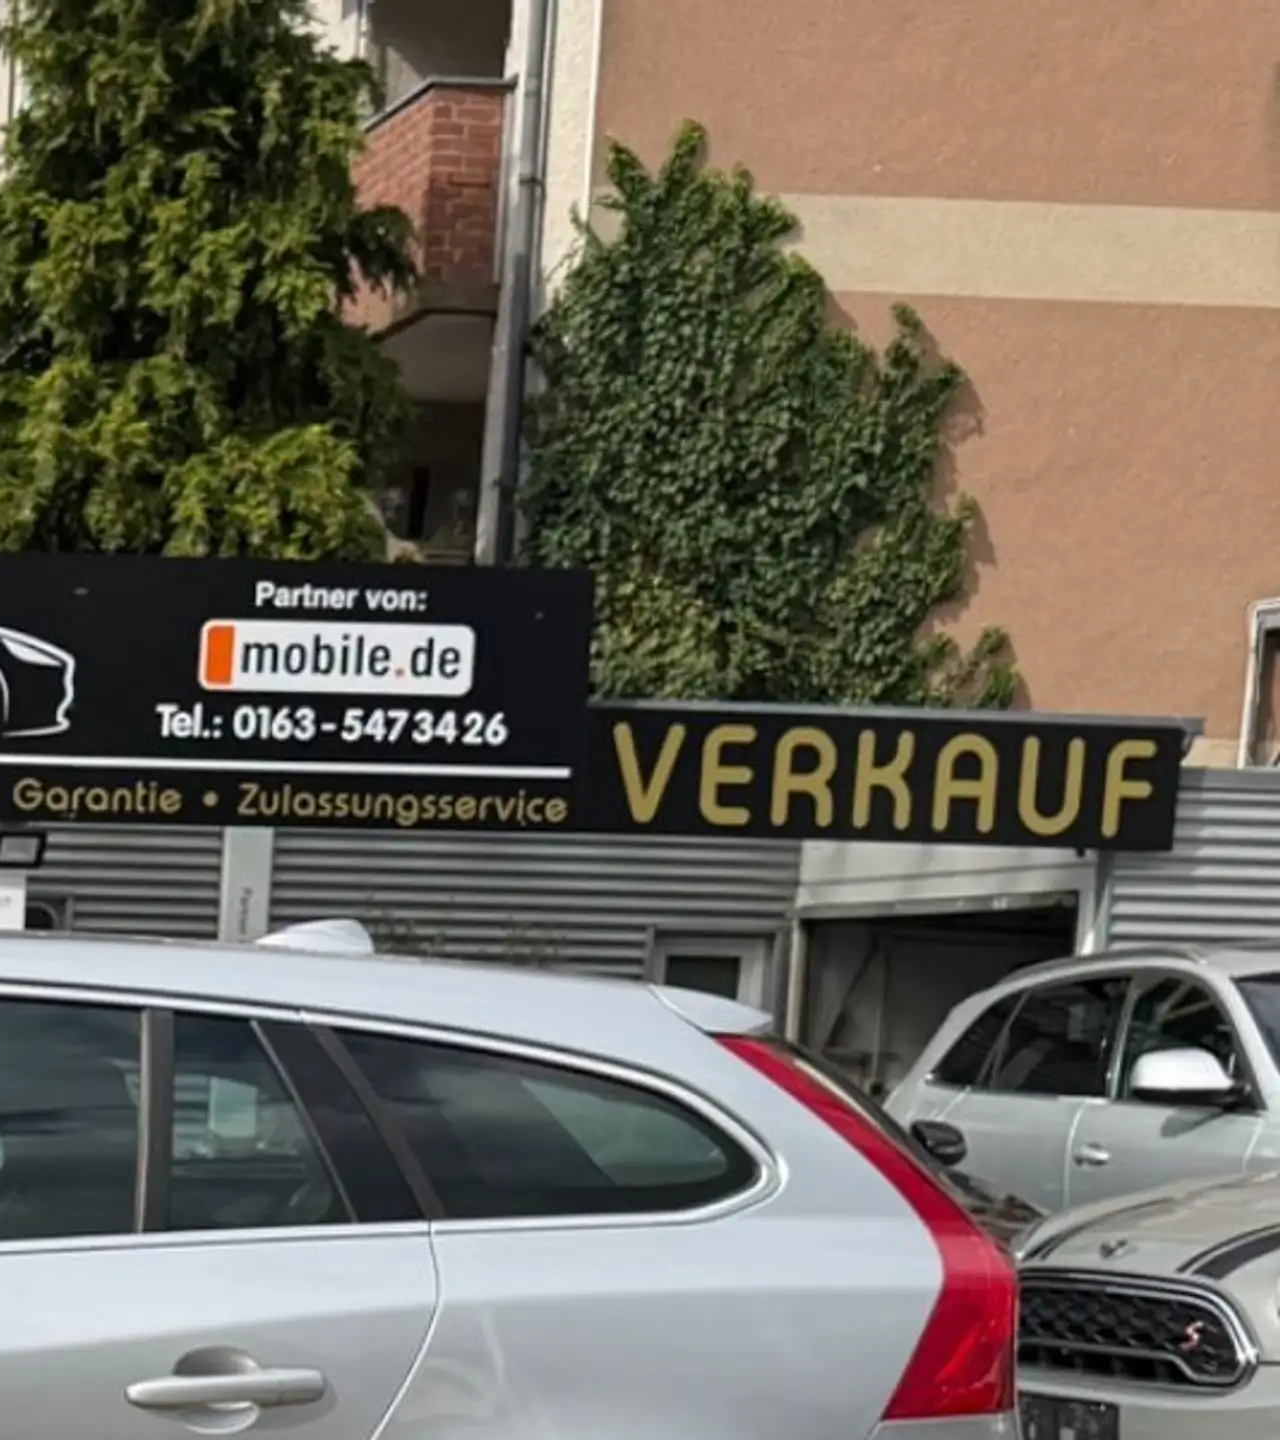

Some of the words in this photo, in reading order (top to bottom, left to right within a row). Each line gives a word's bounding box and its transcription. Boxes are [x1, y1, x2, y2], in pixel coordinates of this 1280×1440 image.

[254, 580, 358, 610] Partner
[364, 588, 428, 612] von:
[240, 633, 462, 680] mobile.de
[155, 701, 223, 739] Tel.:
[13, 778, 181, 813] Garantie
[238, 783, 568, 826] Zulassungsservice
[613, 722, 1157, 838] VERKAUF
